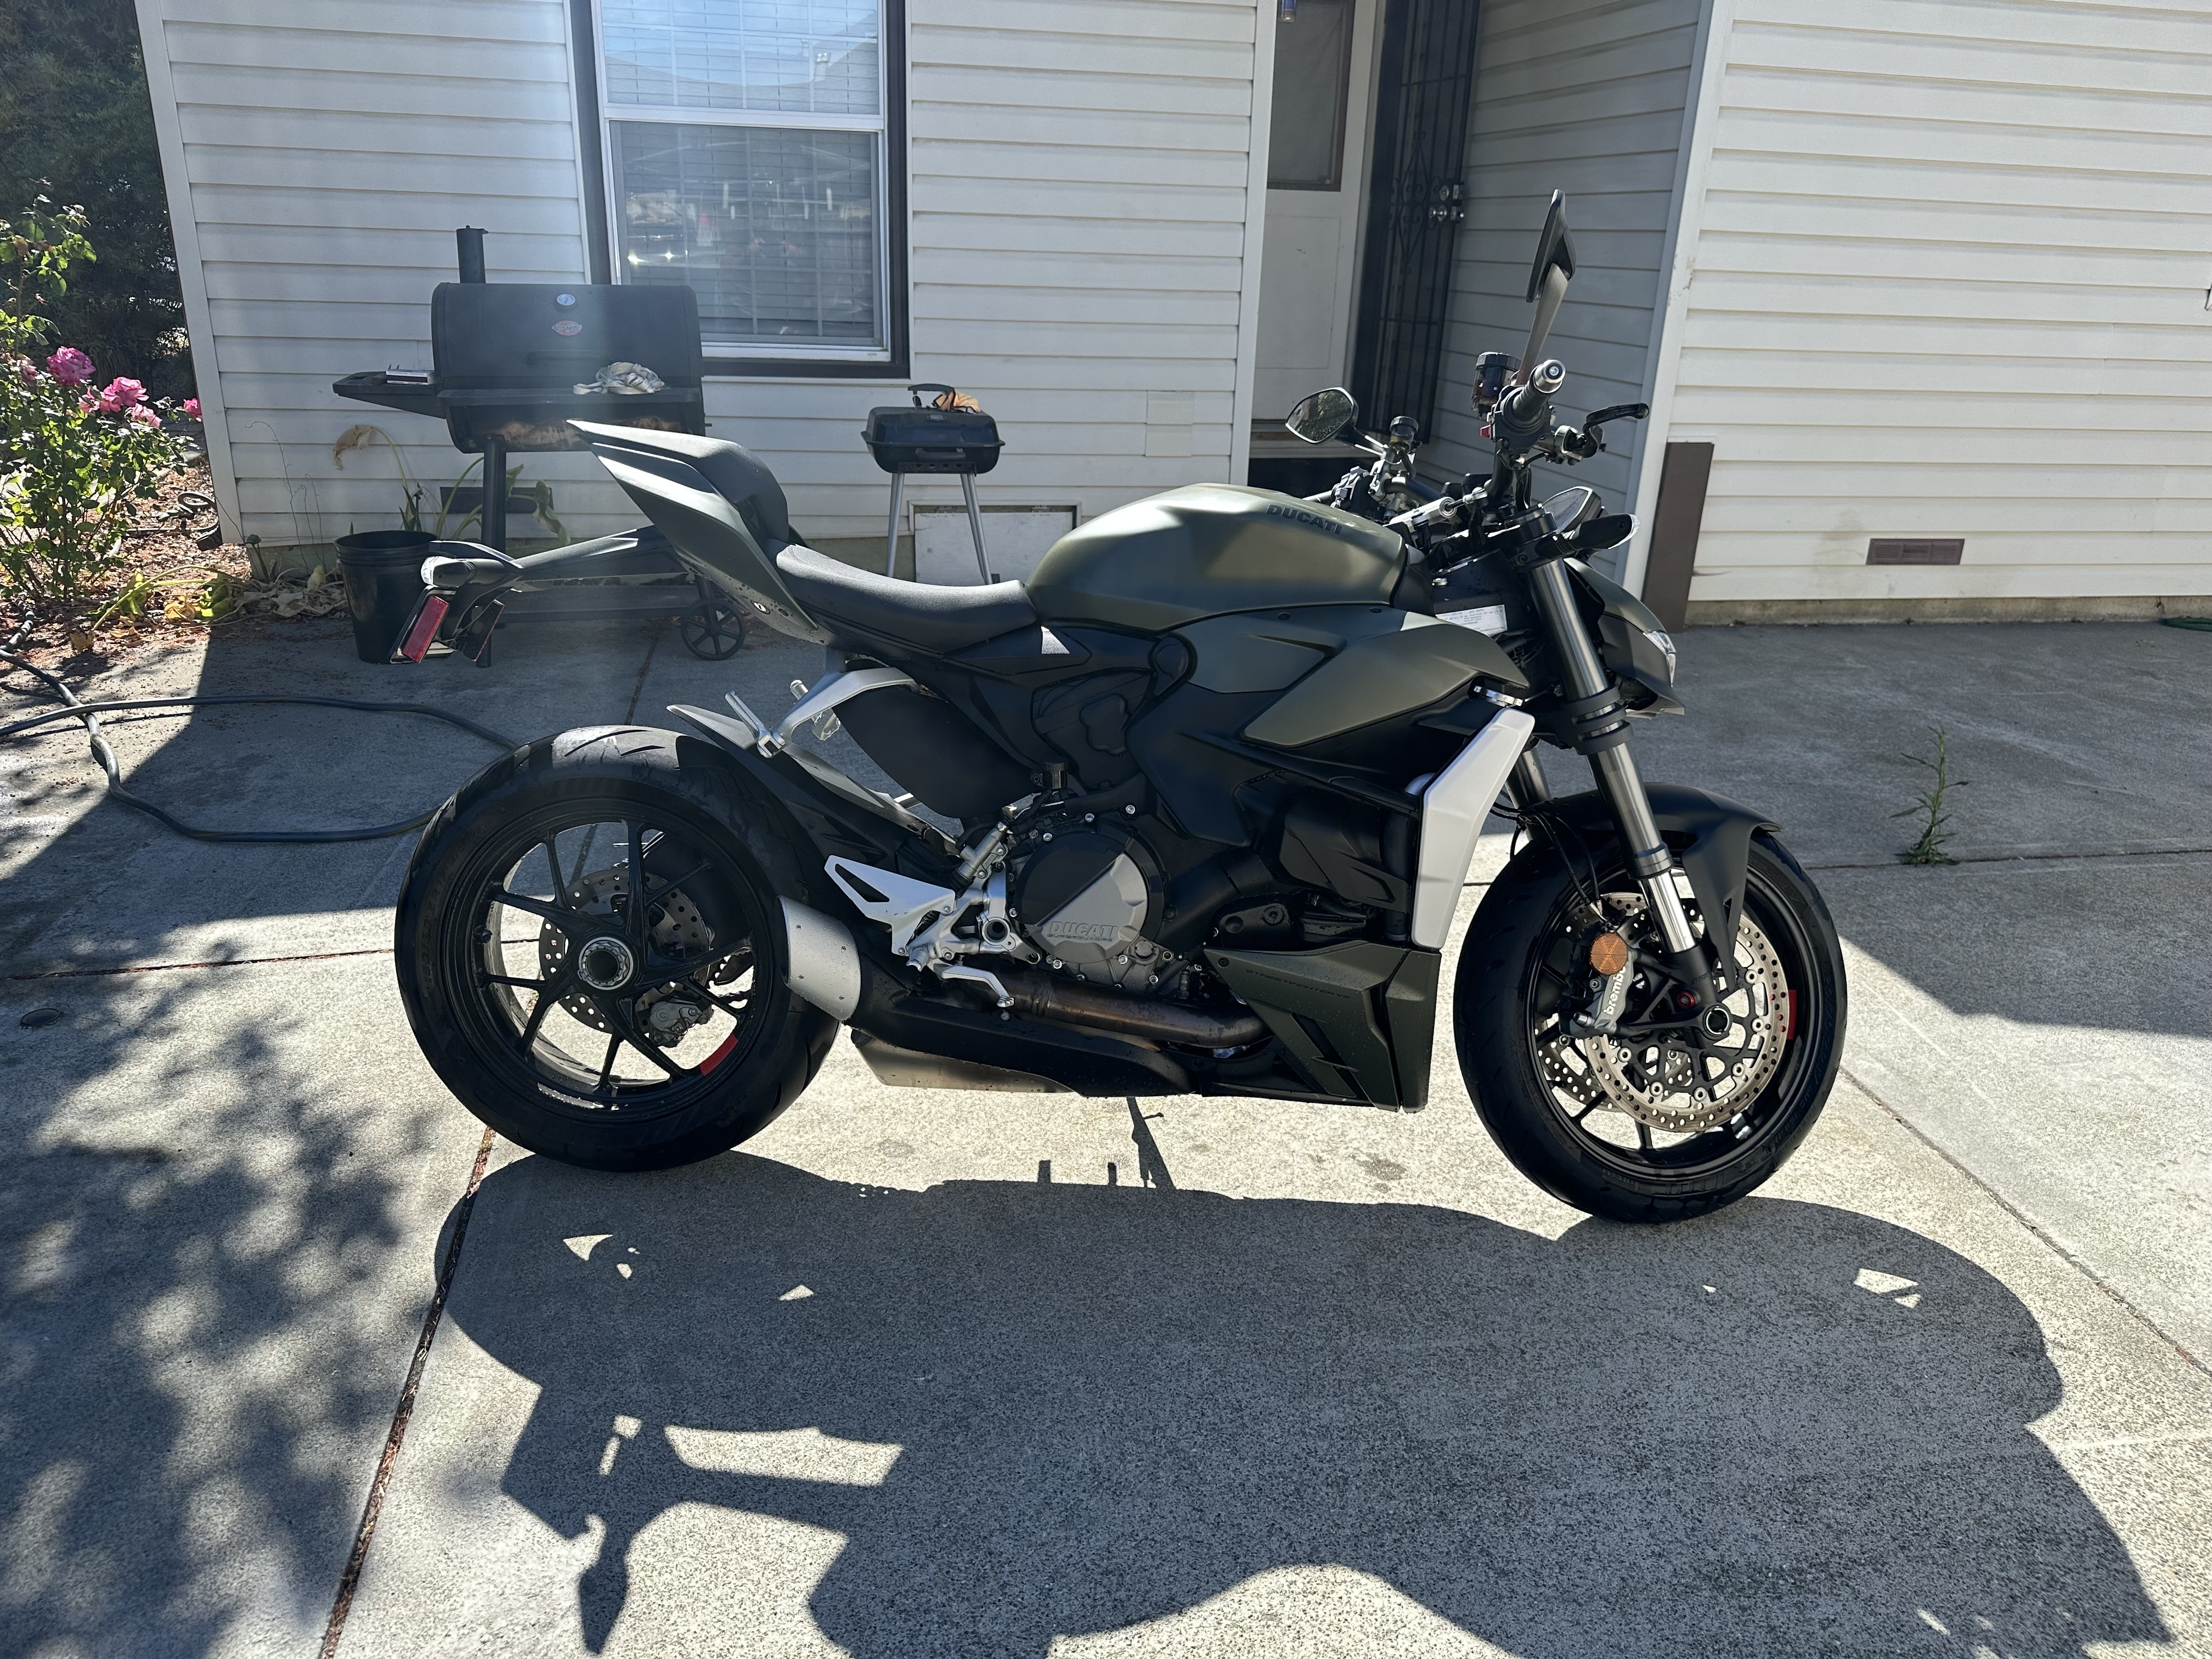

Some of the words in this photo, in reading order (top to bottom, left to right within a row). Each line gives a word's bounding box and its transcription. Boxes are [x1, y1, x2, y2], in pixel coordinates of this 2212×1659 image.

[1266, 504, 1342, 535] DUCATI
[1049, 921, 1118, 939] DUCATI
[1246, 969, 1335, 996] STREETFIGHTER
